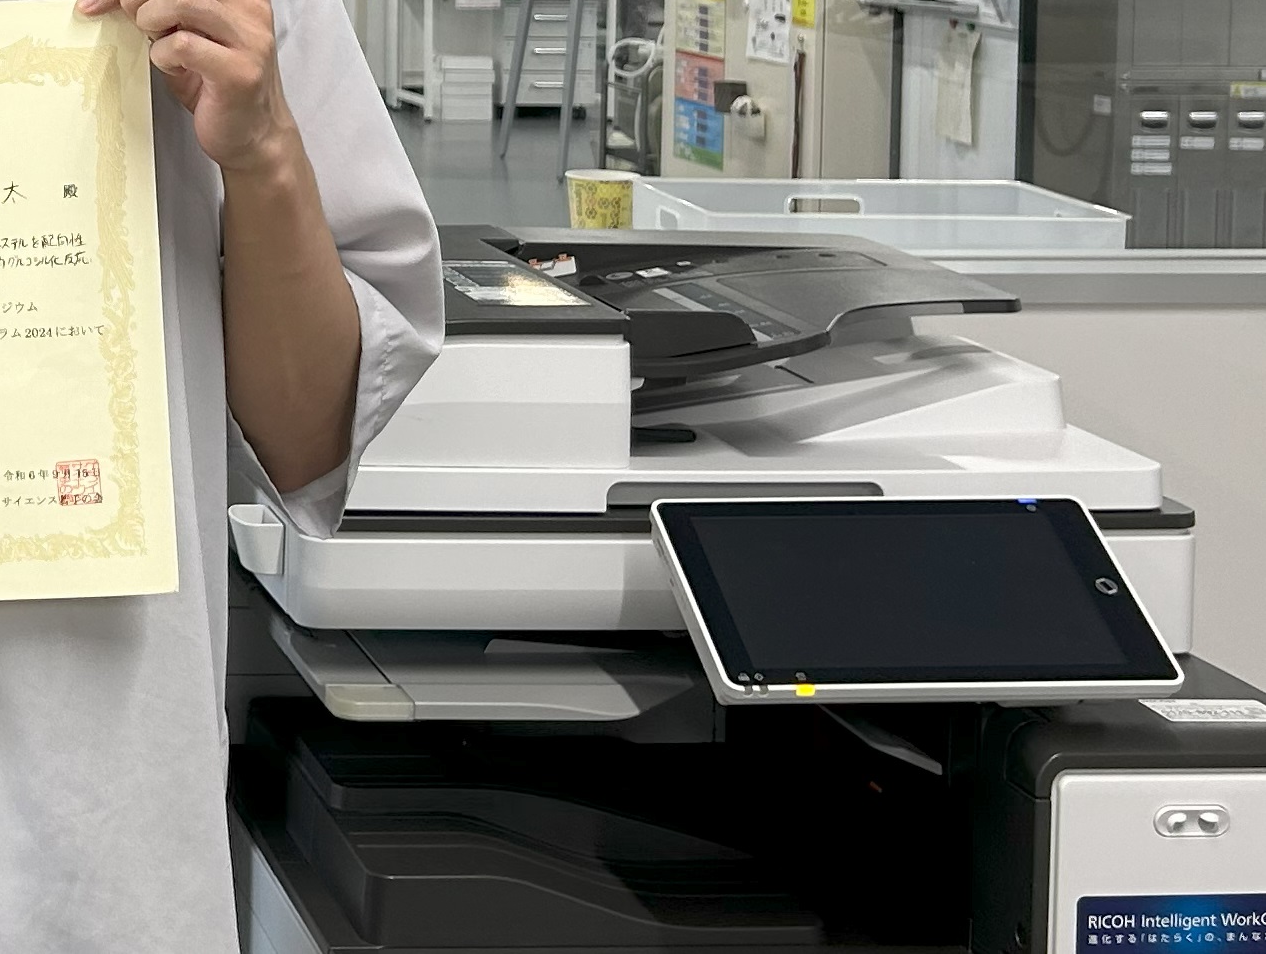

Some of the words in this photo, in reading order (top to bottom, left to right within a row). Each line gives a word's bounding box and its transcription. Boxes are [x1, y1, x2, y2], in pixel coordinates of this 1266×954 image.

[63, 183, 78, 198] 殿
[1088, 914, 1135, 929] RICOH
[1141, 912, 1217, 930] Intelligent
[1088, 932, 1266, 945] 進化する「はたらく」の、まんな
